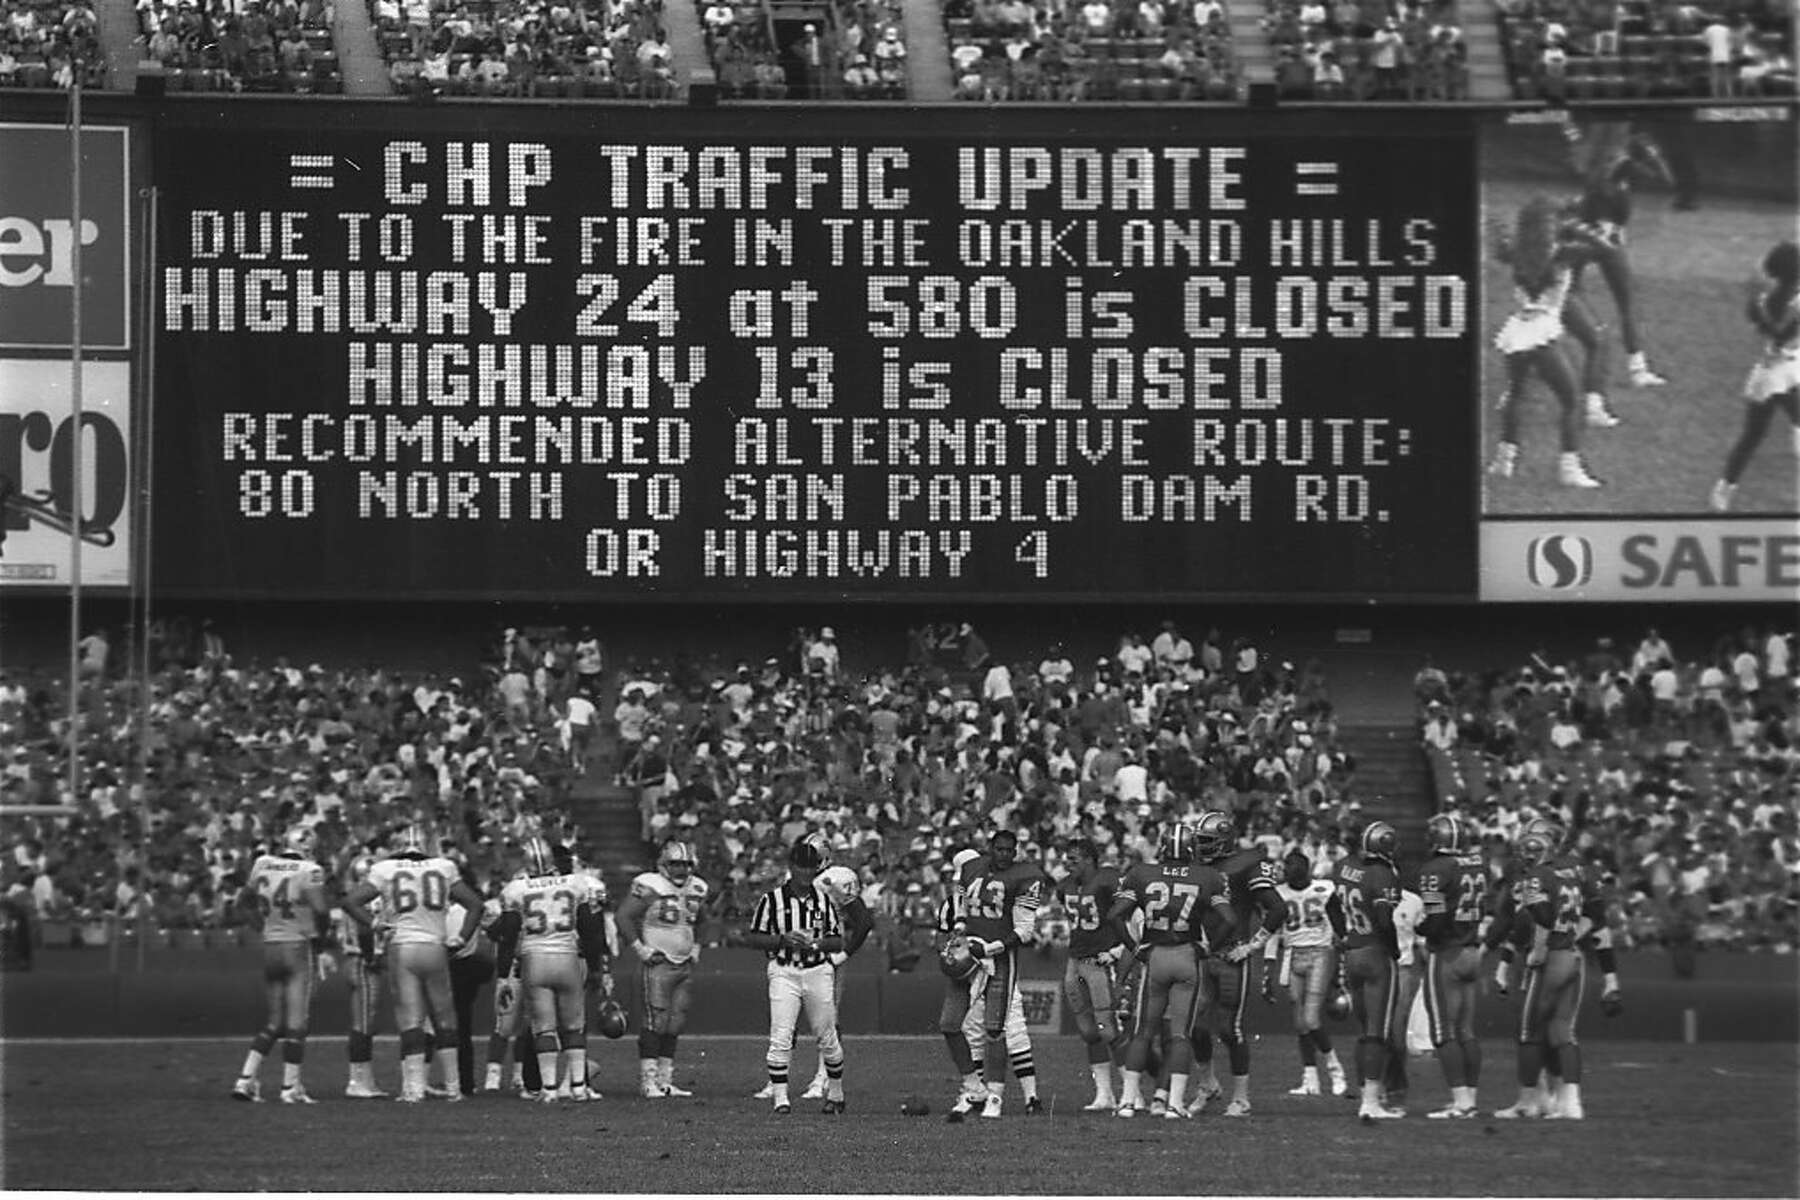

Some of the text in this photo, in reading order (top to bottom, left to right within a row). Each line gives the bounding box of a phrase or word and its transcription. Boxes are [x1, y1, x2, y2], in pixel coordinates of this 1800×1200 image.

[384, 141, 552, 207] CHP
[601, 144, 910, 210] TRAFFIC
[958, 147, 1246, 211] UPDATE
[192, 210, 1435, 268] DUE TO THE FIRE IN THE OAKLAND HILLS
[165, 266, 1467, 340] HIGHWAY 24 at 580 is CLOSED
[348, 341, 1283, 410] HIGHWAY 13 is CLOSED
[223, 413, 1411, 466] RECOMMENDED ALTERNATIVE ROUTE:
[239, 469, 1390, 522] 80 NORTH TO SAN PABLO DAM RD.
[585, 528, 1048, 578] OR HIGHWAY 4
[1621, 535, 1799, 588] SAFE
[393, 869, 447, 913] 60
[522, 891, 576, 934] 53
[966, 877, 1005, 919] 43
[1065, 895, 1100, 931] 53
[1145, 881, 1199, 932] 27
